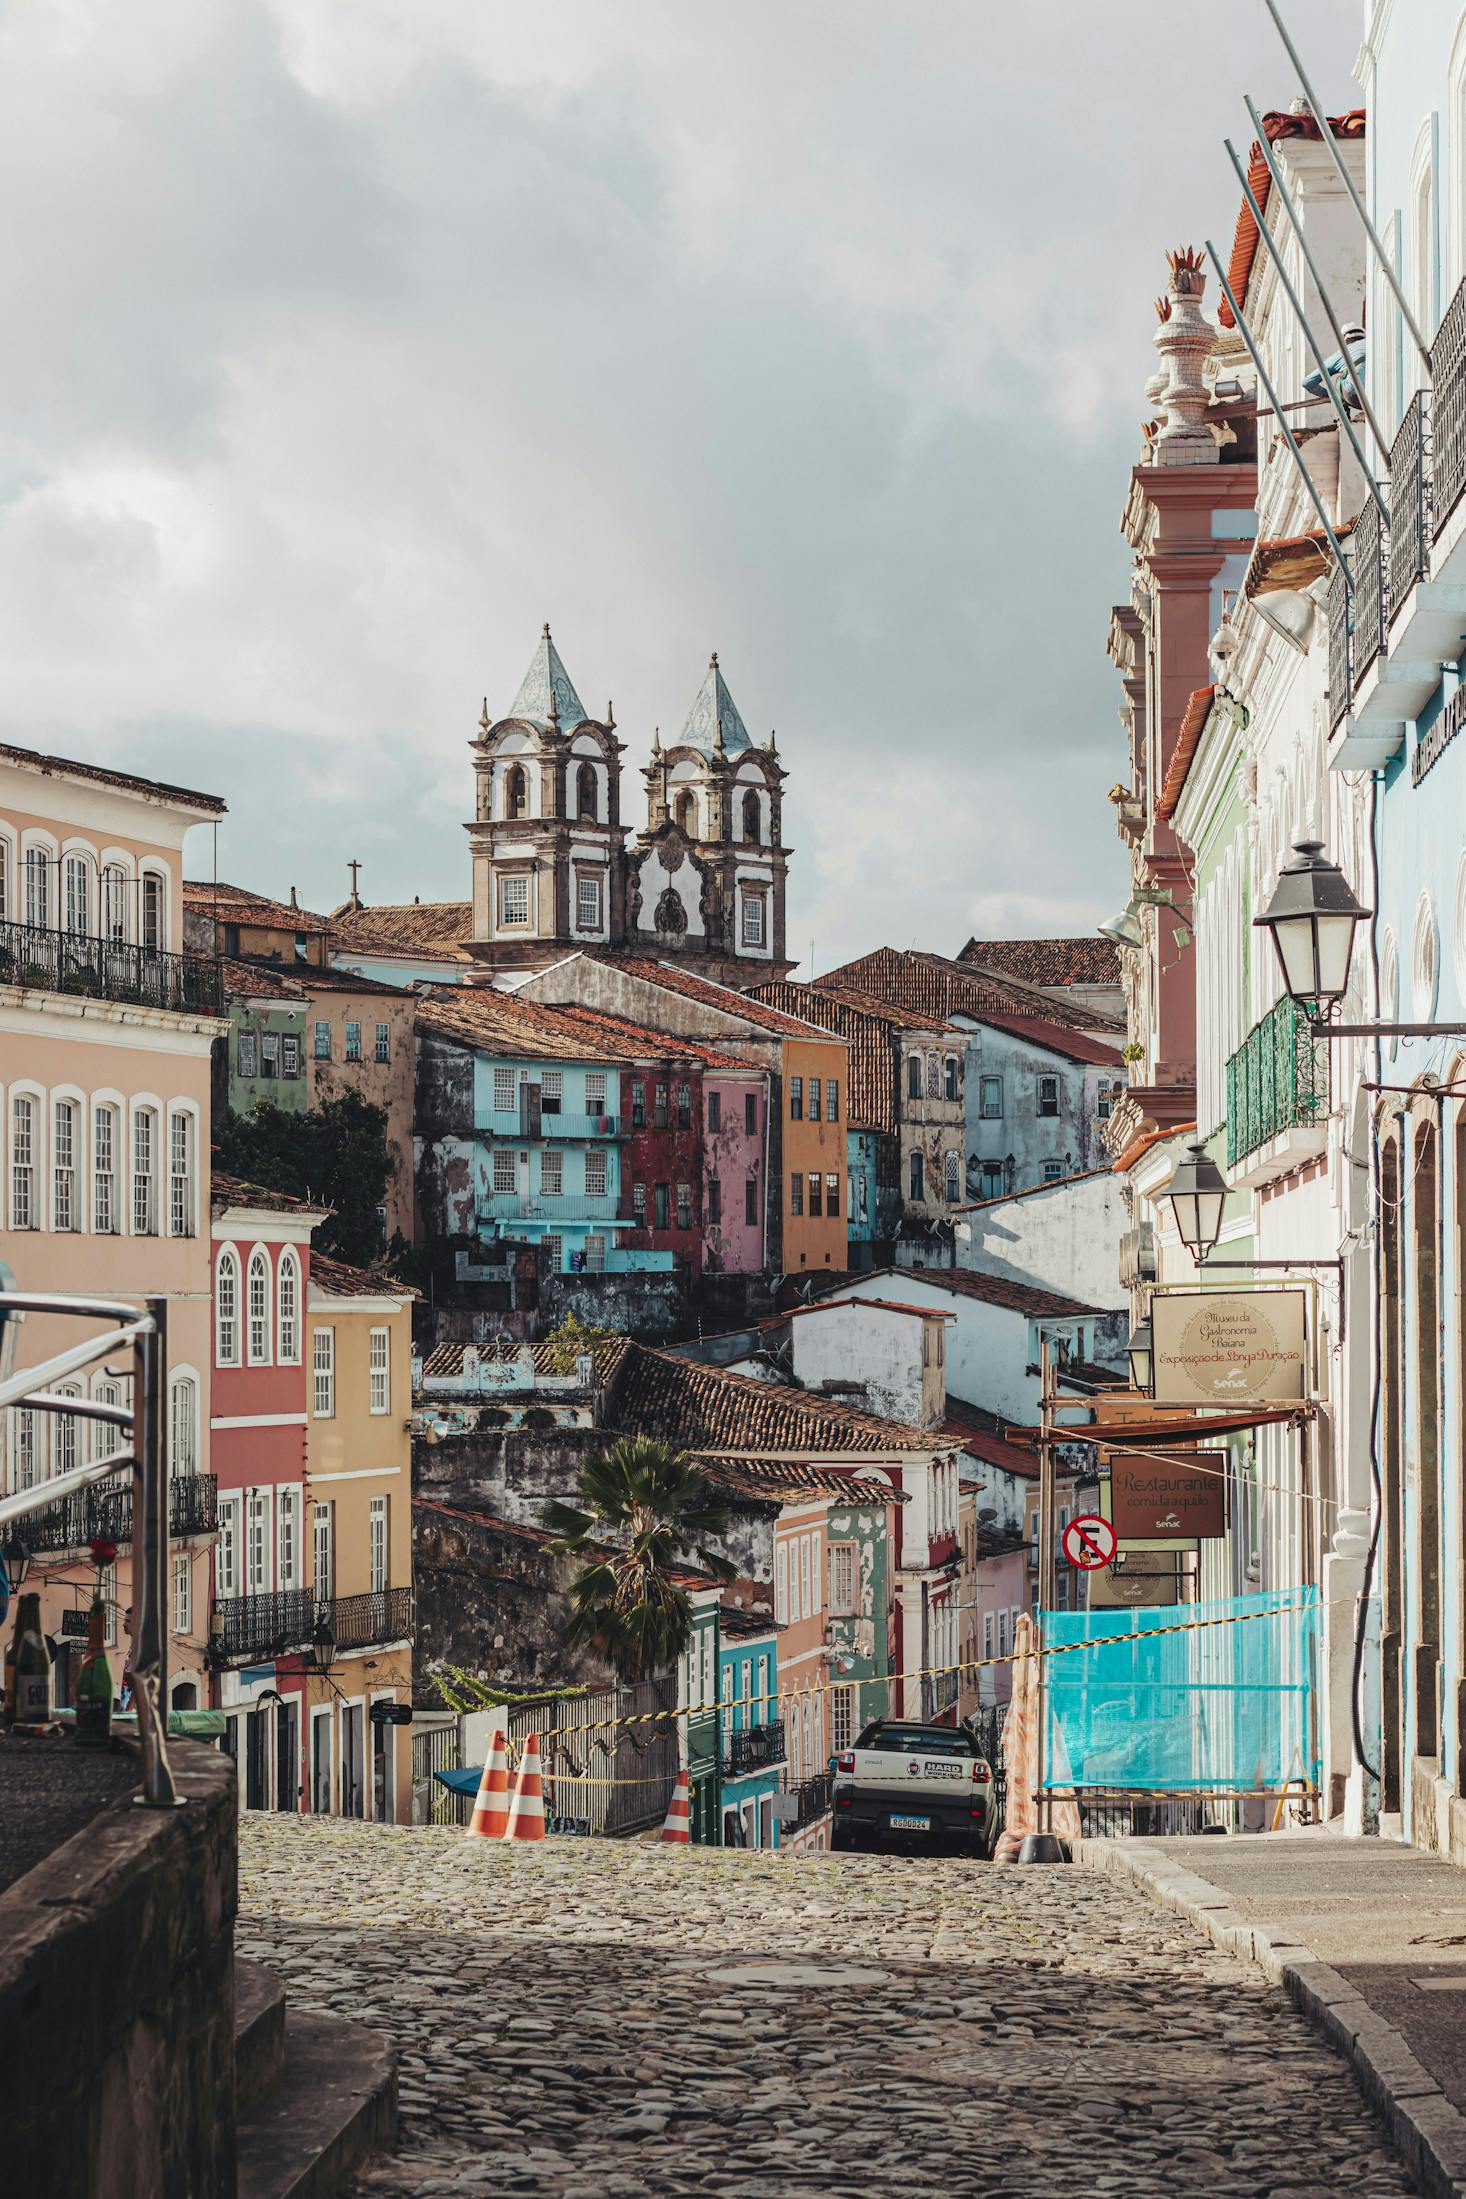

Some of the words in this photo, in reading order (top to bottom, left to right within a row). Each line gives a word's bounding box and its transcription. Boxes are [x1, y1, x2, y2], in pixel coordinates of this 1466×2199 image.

[1204, 1312, 1238, 1324] Museu
[1239, 1311, 1250, 1322] da
[1199, 1324, 1257, 1341] Gastronomia
[1211, 1337, 1246, 1348] Baiana
[1159, 1352, 1210, 1367] Exposição
[1211, 1350, 1225, 1362] de
[1225, 1350, 1257, 1368] Longa
[1256, 1349, 1300, 1366] Duração
[1116, 1471, 1218, 1492] Restaurante
[1127, 1494, 1169, 1507] comida
[1170, 1497, 1178, 1507] a
[1178, 1494, 1209, 1513] quilo
[927, 1763, 961, 1773] HARD
